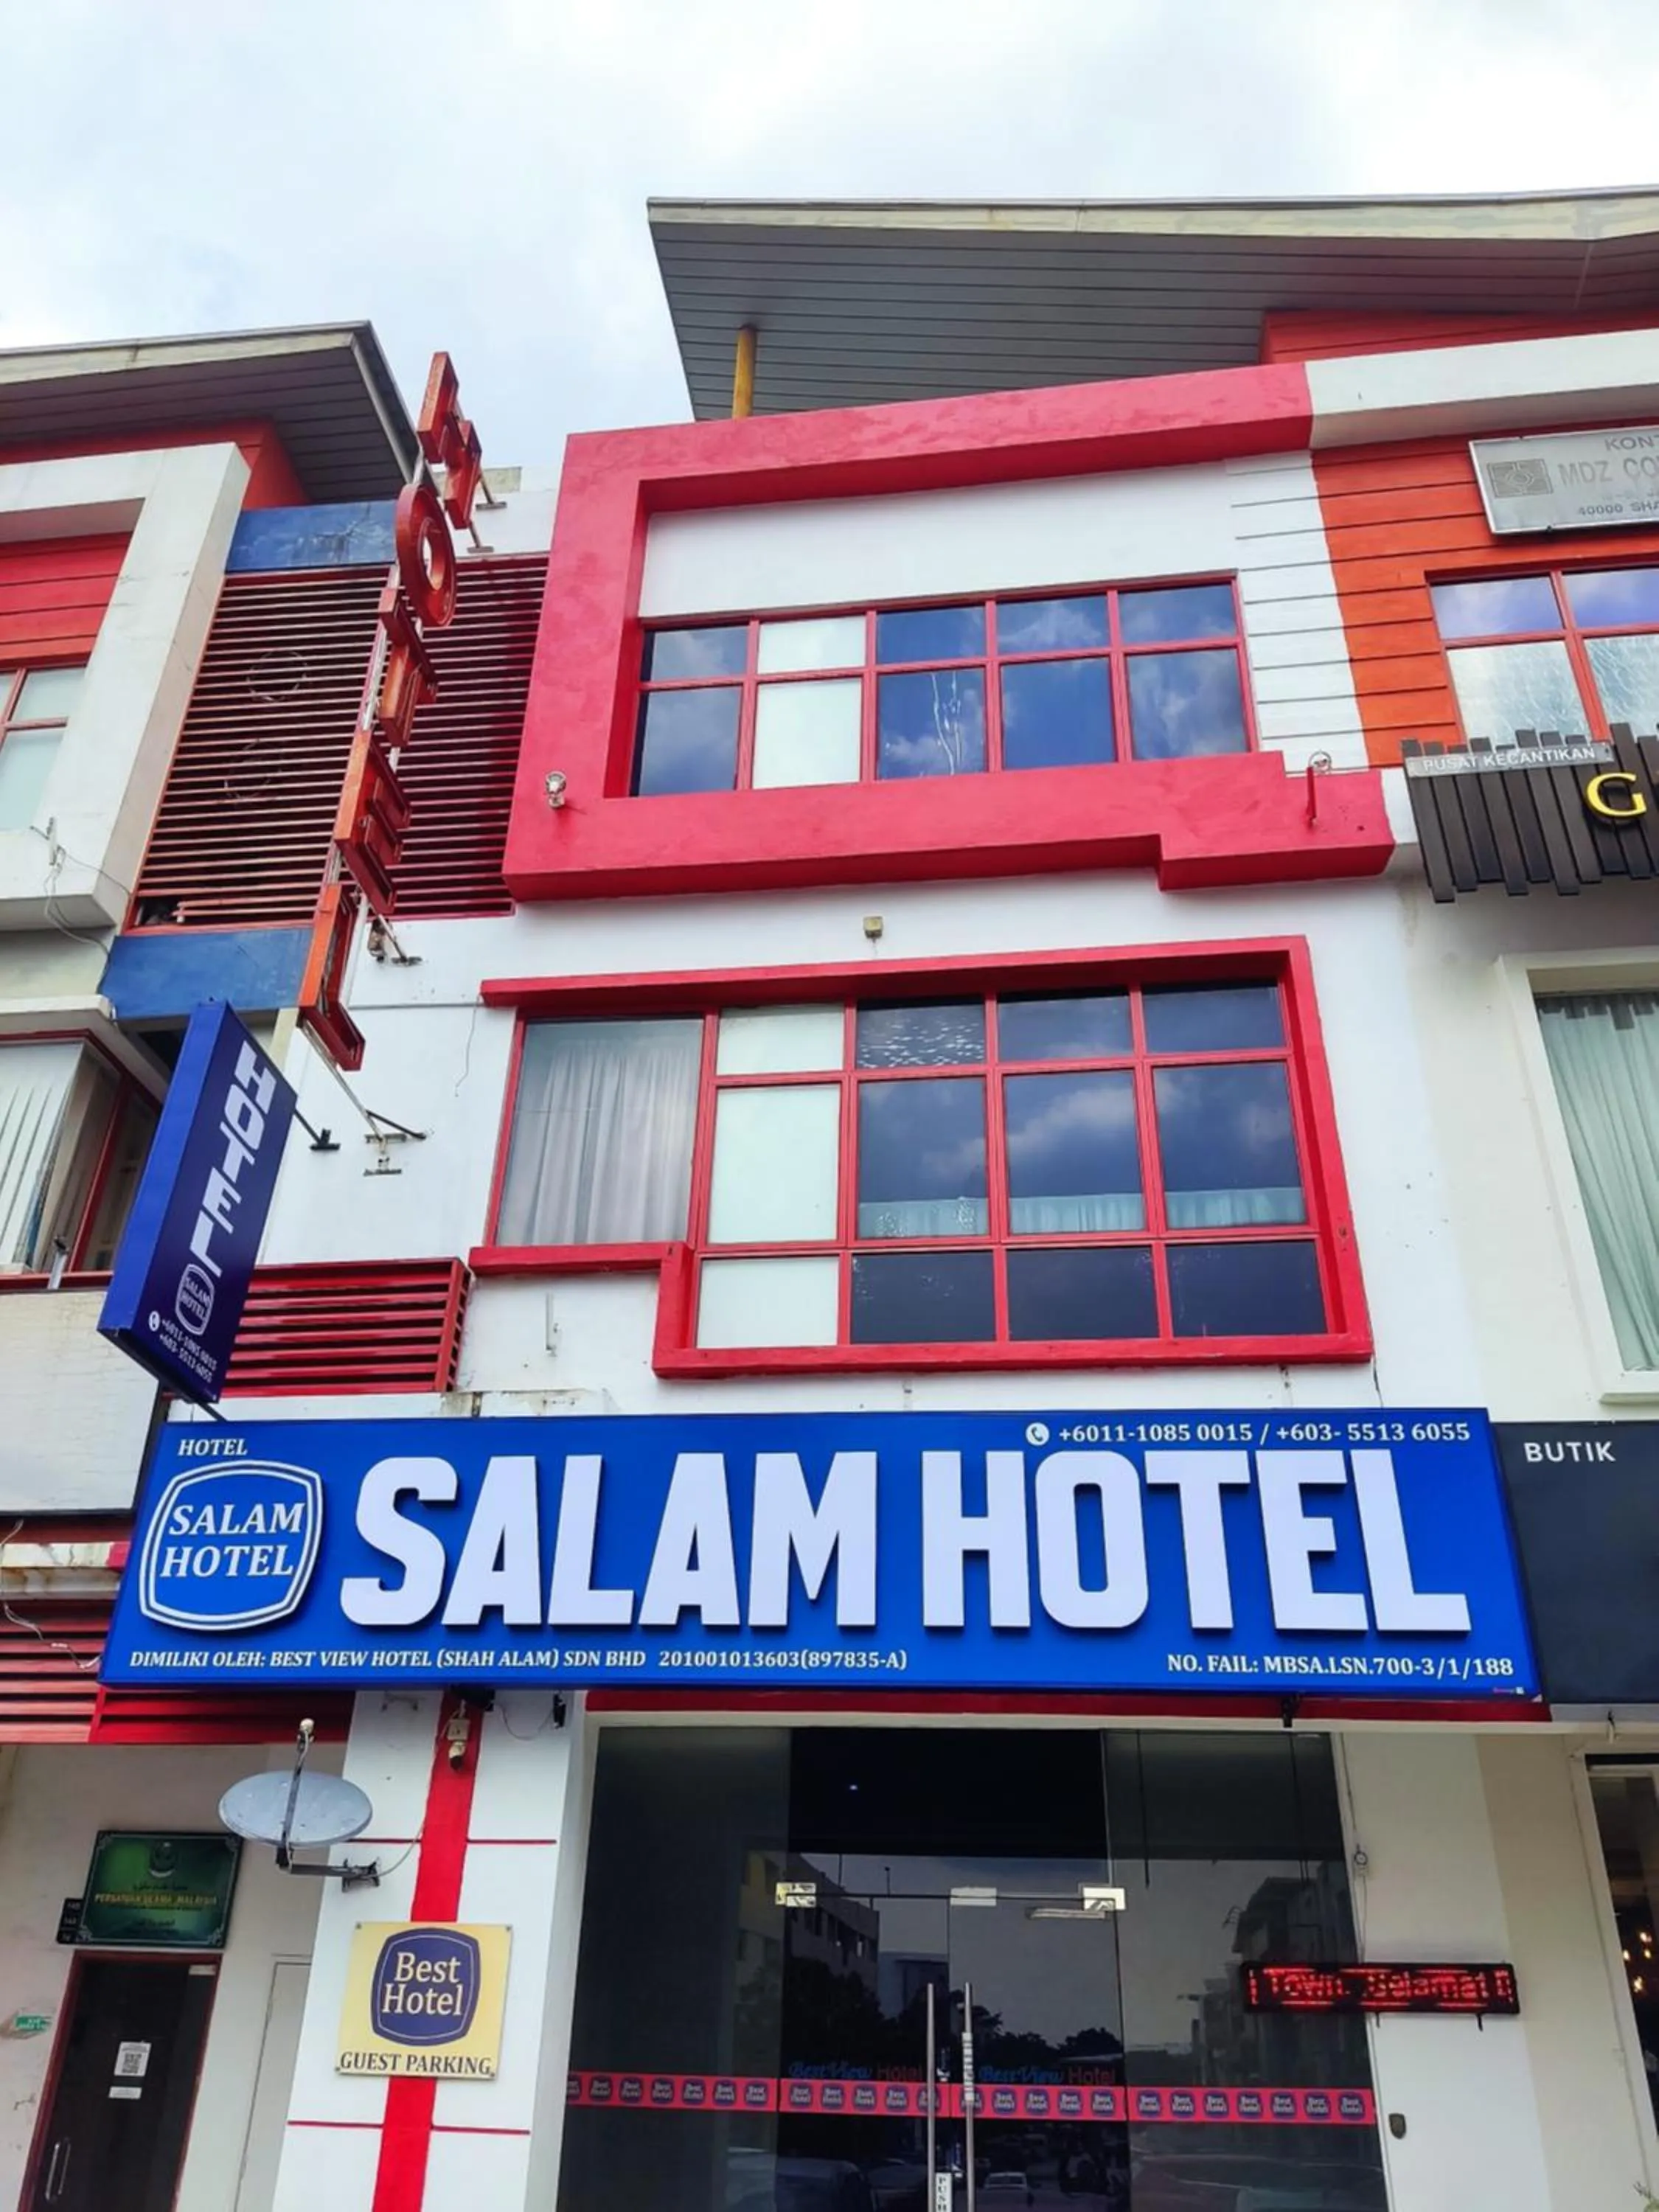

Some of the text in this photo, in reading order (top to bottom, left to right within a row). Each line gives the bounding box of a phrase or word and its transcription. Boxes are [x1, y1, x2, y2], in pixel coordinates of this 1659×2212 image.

[1557, 456, 1659, 488] MDZ CO
[1422, 746, 1596, 771] PUSAT KECANTIKAN
[189, 1040, 277, 1278] HOTEL
[1059, 1424, 1191, 1443] +6011-1085
[1197, 1423, 1253, 1441] 0015
[1276, 1424, 1342, 1442] +603-
[1348, 1423, 1405, 1441] 5513
[1412, 1422, 1470, 1441] 6055
[178, 1439, 248, 1457] HOTEL
[1523, 1441, 1616, 1462] BUTIK
[169, 1502, 305, 1536] SALAM
[340, 1449, 1472, 1632] SALAM HOTEL
[160, 1545, 295, 1578] HOTEL
[130, 1651, 209, 1667] DIMILIKI
[212, 1651, 266, 1667] OLEH:
[270, 1652, 316, 1667] BEST
[318, 1652, 369, 1667] VIEW
[371, 1652, 432, 1667] HOTEL
[437, 1649, 495, 1669] (SHAH
[498, 1649, 560, 1669] ALAM)
[563, 1652, 601, 1667] SDN
[605, 1652, 646, 1667] BHD
[1167, 1655, 1203, 1672] NO.
[1208, 1655, 1259, 1673] FAIL:
[394, 1952, 462, 1983] Best
[382, 1983, 464, 2016] Hotel
[341, 2051, 492, 2076] GUEST PARKING
